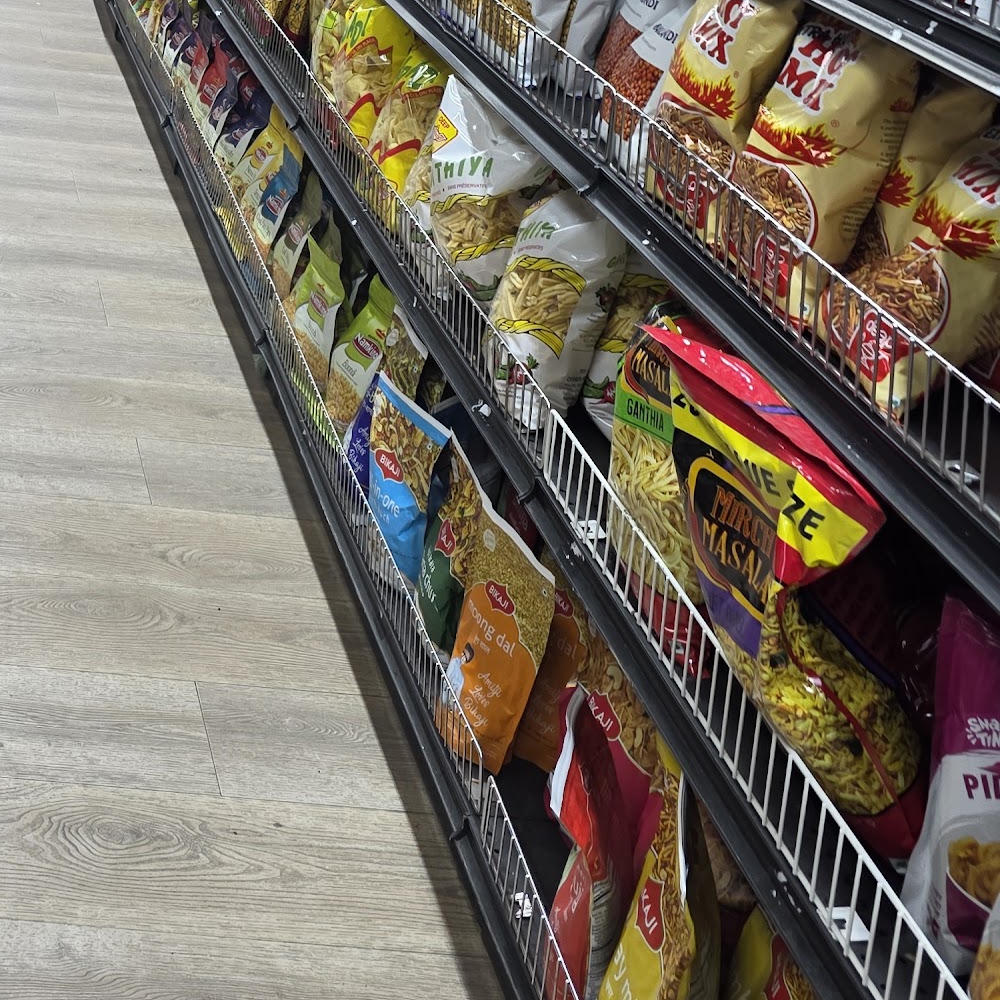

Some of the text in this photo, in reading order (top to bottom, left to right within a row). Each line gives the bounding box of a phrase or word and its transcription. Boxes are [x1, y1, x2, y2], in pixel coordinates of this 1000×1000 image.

[438, 115, 450, 129] DEEP
[433, 154, 494, 184] THIYA
[631, 348, 671, 396] MASAL
[626, 398, 664, 433] GANTHIA
[379, 453, 400, 478] BIKAJI
[711, 484, 775, 557] MIRCH
[701, 518, 774, 605] MASALA
[488, 584, 509, 609] BIKAJI
[554, 592, 571, 613] IKAJI
[495, 633, 514, 658] dal
[588, 696, 614, 732] BIKAJI
[978, 732, 1000, 748] TIM
[641, 888, 658, 935] KAJI
